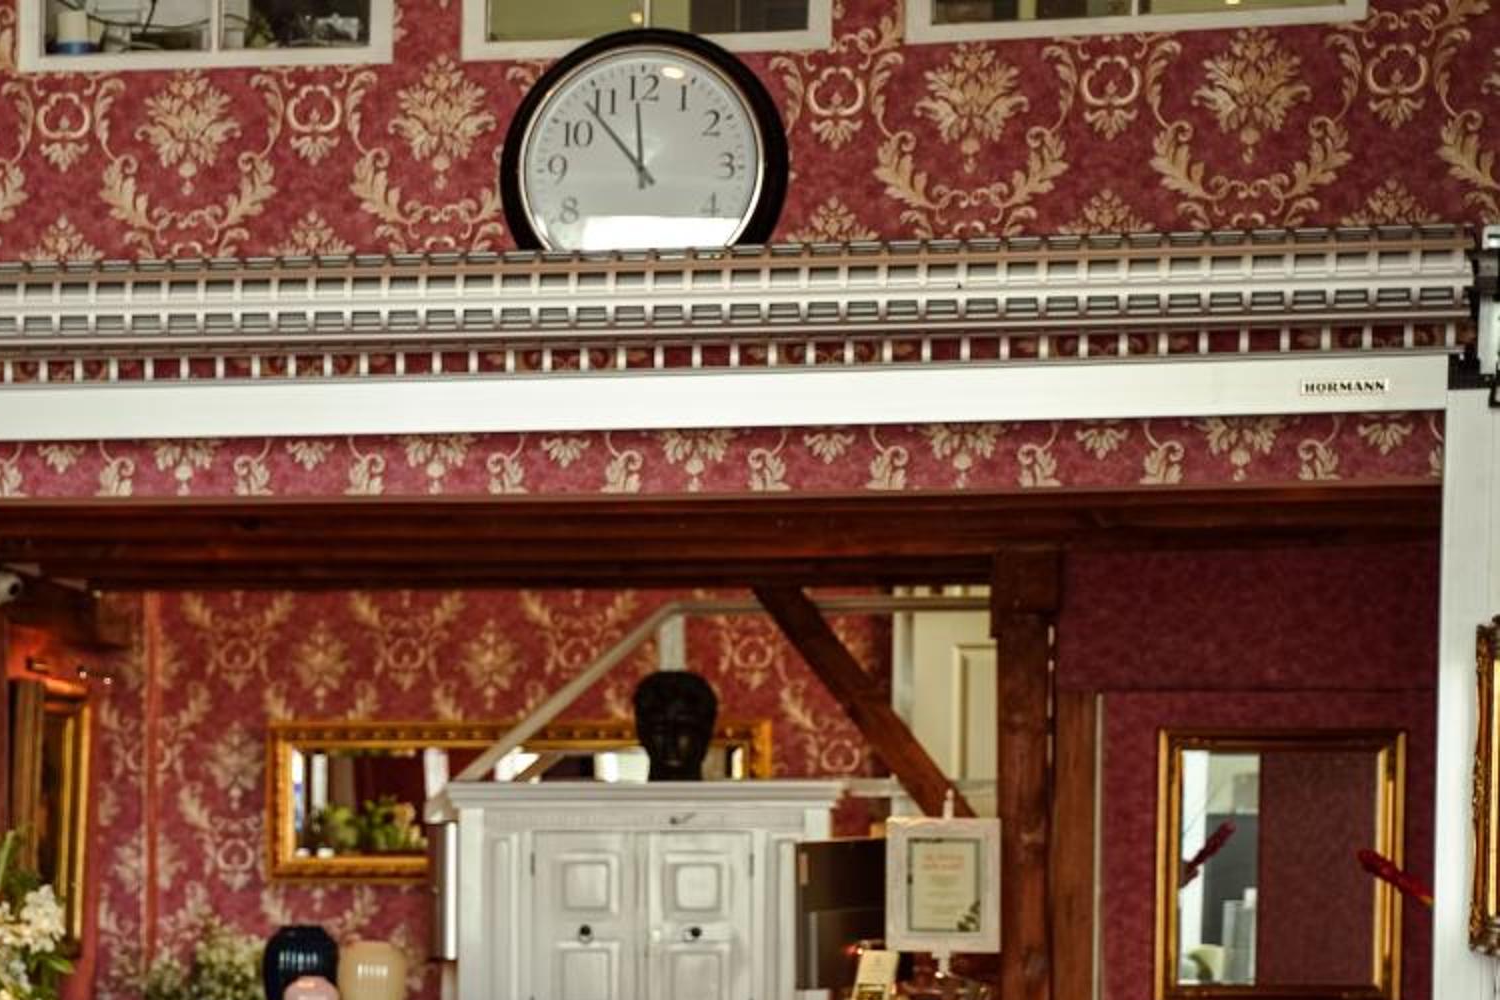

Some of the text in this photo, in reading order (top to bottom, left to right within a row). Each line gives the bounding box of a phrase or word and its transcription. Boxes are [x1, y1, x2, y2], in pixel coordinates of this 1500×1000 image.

[594, 87, 618, 117] 11
[629, 73, 659, 102] 12
[677, 84, 688, 112] 1
[563, 119, 593, 148] 10
[702, 109, 721, 138] 2
[548, 155, 568, 184] 9
[719, 152, 736, 180] 3
[559, 196, 579, 225] 8
[700, 191, 721, 218] 4
